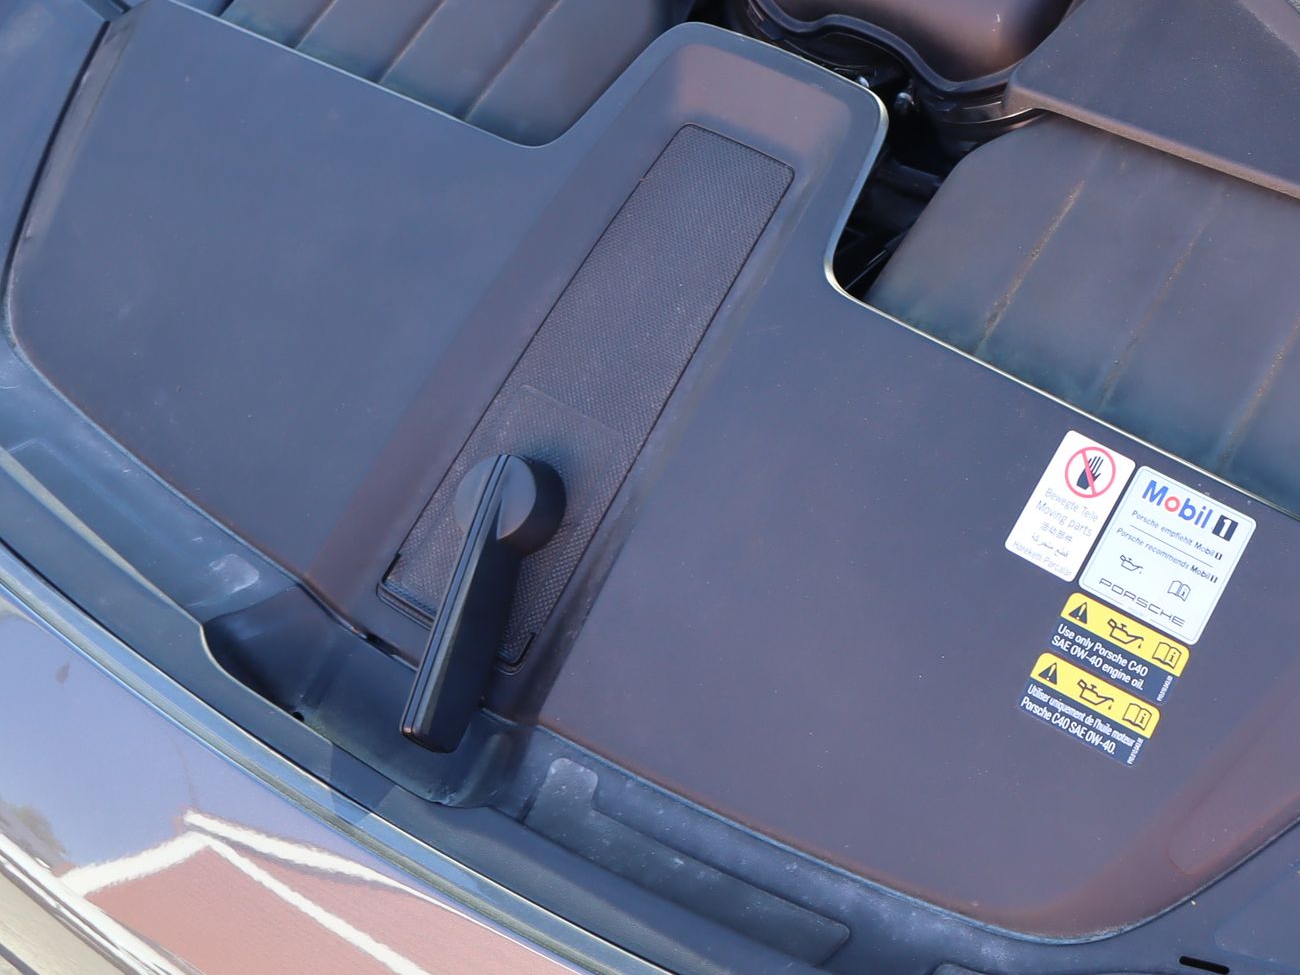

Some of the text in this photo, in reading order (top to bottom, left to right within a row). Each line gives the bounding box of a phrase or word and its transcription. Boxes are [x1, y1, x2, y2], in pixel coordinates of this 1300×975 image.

[1035, 500, 1093, 537] Moving parts
[1142, 479, 1214, 528] Mobil
[1116, 527, 1144, 546] Porsche
[1145, 542, 1190, 569] recommends
[1190, 564, 1211, 580] Mobil
[1132, 510, 1159, 529] Porsche
[1194, 541, 1216, 557] Mobil
[1099, 577, 1186, 628] PORSCHE
[1051, 635, 1069, 652] SAE
[1070, 645, 1103, 668] 0W-40
[1101, 663, 1130, 683] engine
[1130, 677, 1144, 691] oil.
[1057, 623, 1148, 677] Use only Porsche C40
[1020, 696, 1052, 721] Porsche
[1051, 713, 1069, 729] C40
[1068, 722, 1087, 739] SAE
[1027, 683, 1051, 703] Utiliser
[1049, 698, 1085, 723] uniquement
[1084, 712, 1094, 725] de
[1111, 728, 1136, 747] moteur
